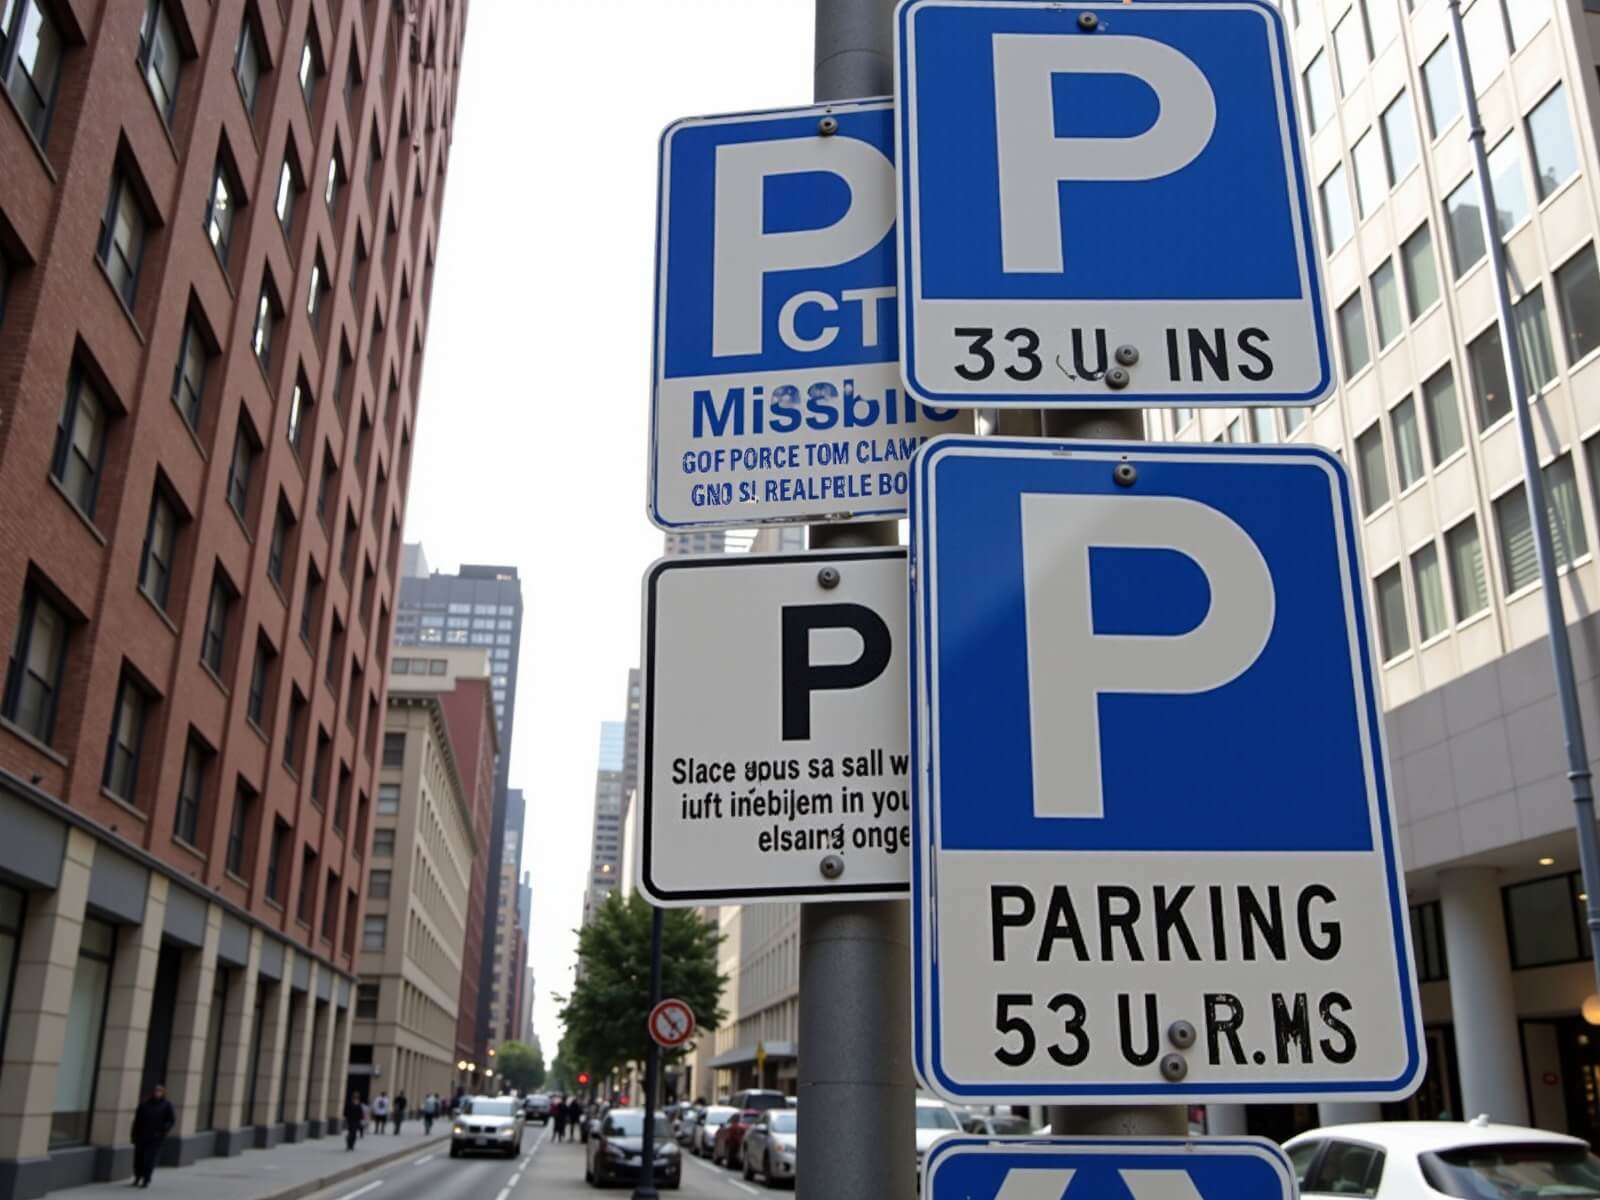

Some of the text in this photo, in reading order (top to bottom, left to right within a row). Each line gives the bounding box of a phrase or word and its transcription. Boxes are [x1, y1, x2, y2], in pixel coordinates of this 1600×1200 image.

[992, 33, 1217, 274] P
[711, 135, 897, 358] P
[954, 327, 1042, 382] 33
[1166, 327, 1274, 382] INS
[805, 441, 849, 467] TOM
[781, 603, 893, 741] P
[1020, 492, 1276, 819] P
[672, 757, 736, 785] Slace
[808, 757, 835, 779] sa
[841, 748, 883, 778] sall
[841, 786, 864, 814] in
[990, 884, 1343, 962] PARKING
[994, 992, 1091, 1067] 53
